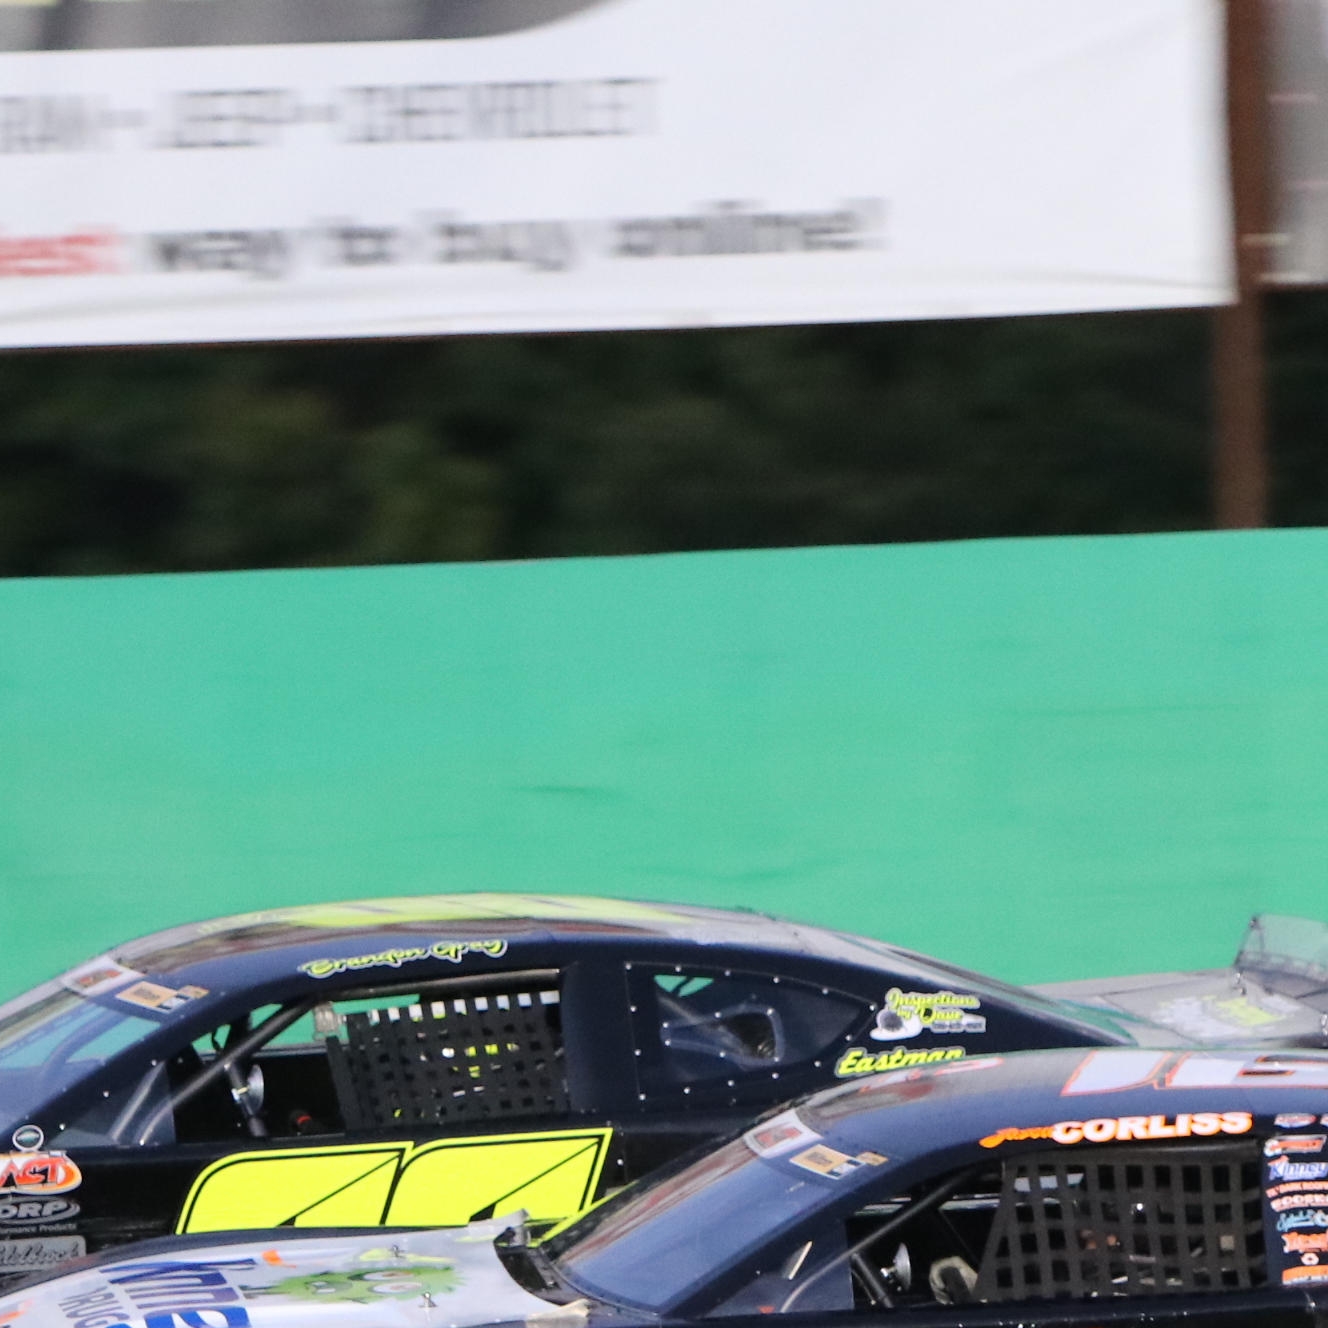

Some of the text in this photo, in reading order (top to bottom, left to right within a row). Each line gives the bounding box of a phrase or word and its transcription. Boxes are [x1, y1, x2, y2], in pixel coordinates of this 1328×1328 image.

[340, 77, 662, 146] CHEVROLET
[149, 225, 286, 284] way
[322, 216, 410, 266] to
[430, 212, 574, 274] buy
[431, 939, 505, 961] Gray
[889, 993, 979, 1009] Inspections
[914, 1006, 963, 1025] Dave
[837, 1048, 963, 1076] Eastman
[1053, 1112, 1252, 1145] CORLISS
[39, 1222, 77, 1233] Products
